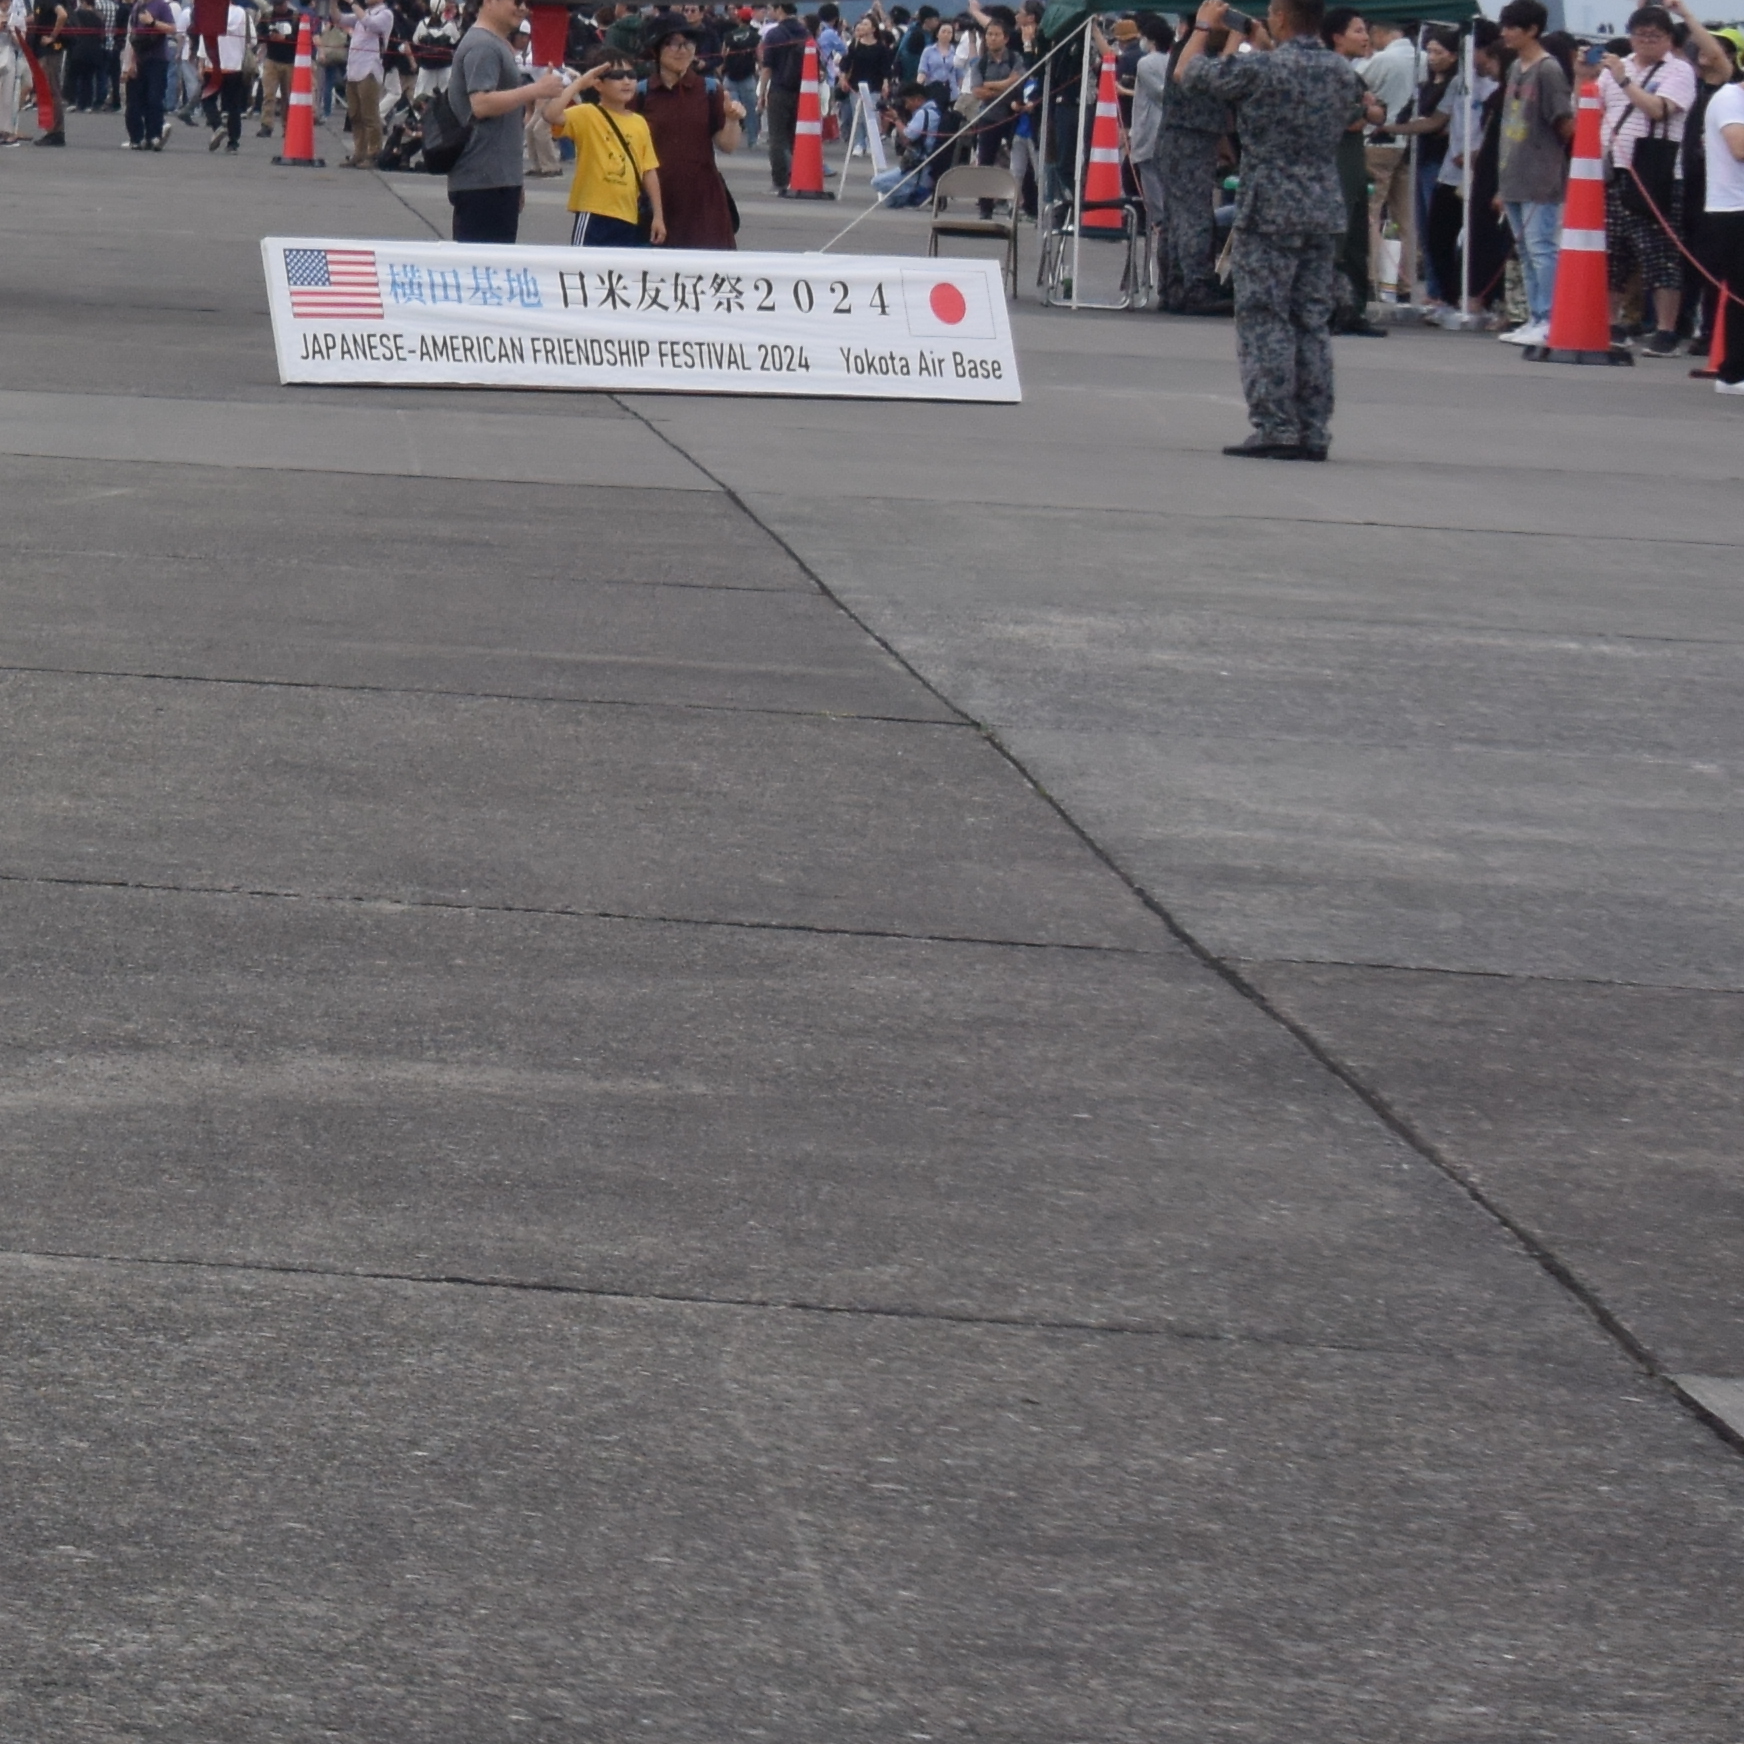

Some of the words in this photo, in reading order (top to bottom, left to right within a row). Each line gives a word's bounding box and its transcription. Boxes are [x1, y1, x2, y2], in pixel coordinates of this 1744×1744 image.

[388, 262, 544, 309] 横田基地
[299, 332, 526, 365] JAPANESE-AMERICAN
[530, 336, 651, 368] FRIENDSHIP
[657, 340, 752, 371] FESTIVAL
[757, 344, 811, 373] 2024
[839, 346, 911, 377] Yokota
[918, 350, 946, 378] Air
[952, 351, 1003, 380] Base
